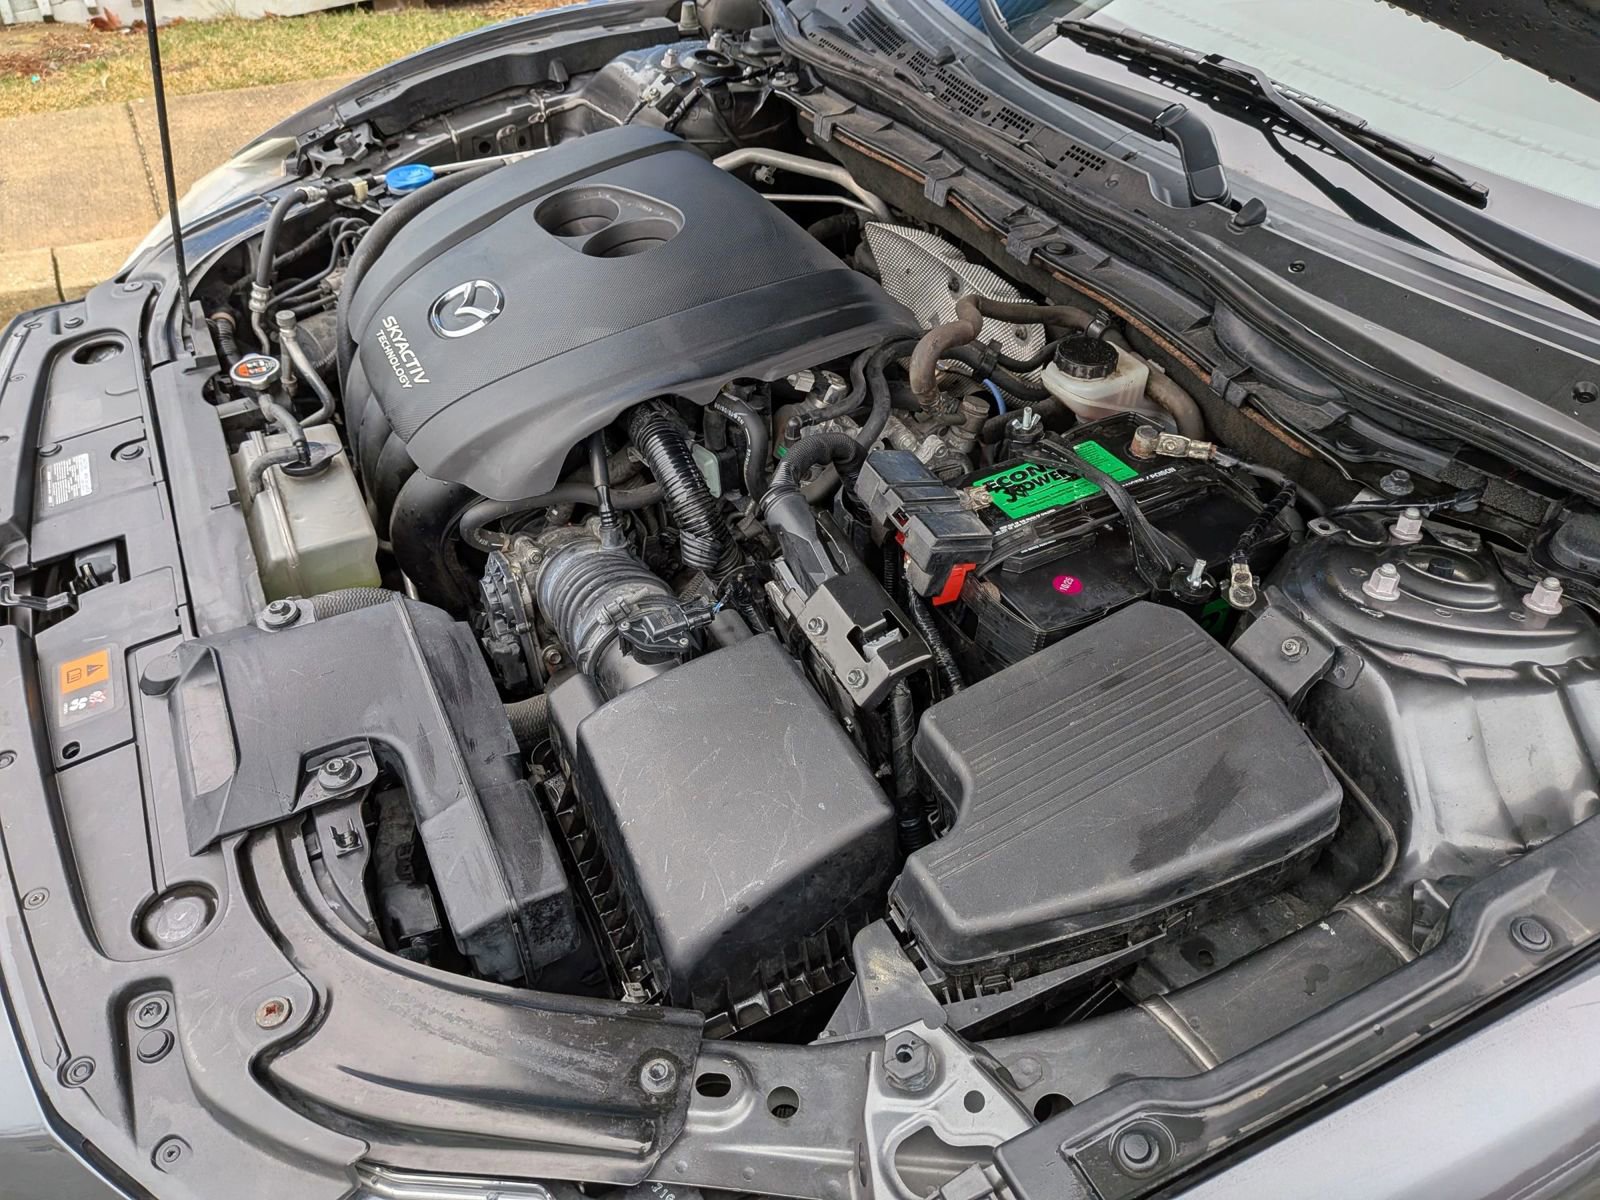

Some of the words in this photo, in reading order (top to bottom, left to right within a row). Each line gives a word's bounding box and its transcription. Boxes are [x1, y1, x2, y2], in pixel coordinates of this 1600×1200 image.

[376, 329, 413, 388] TECHNOLOGY
[382, 315, 430, 383] SKYACTIV
[985, 463, 1056, 491] ECON
